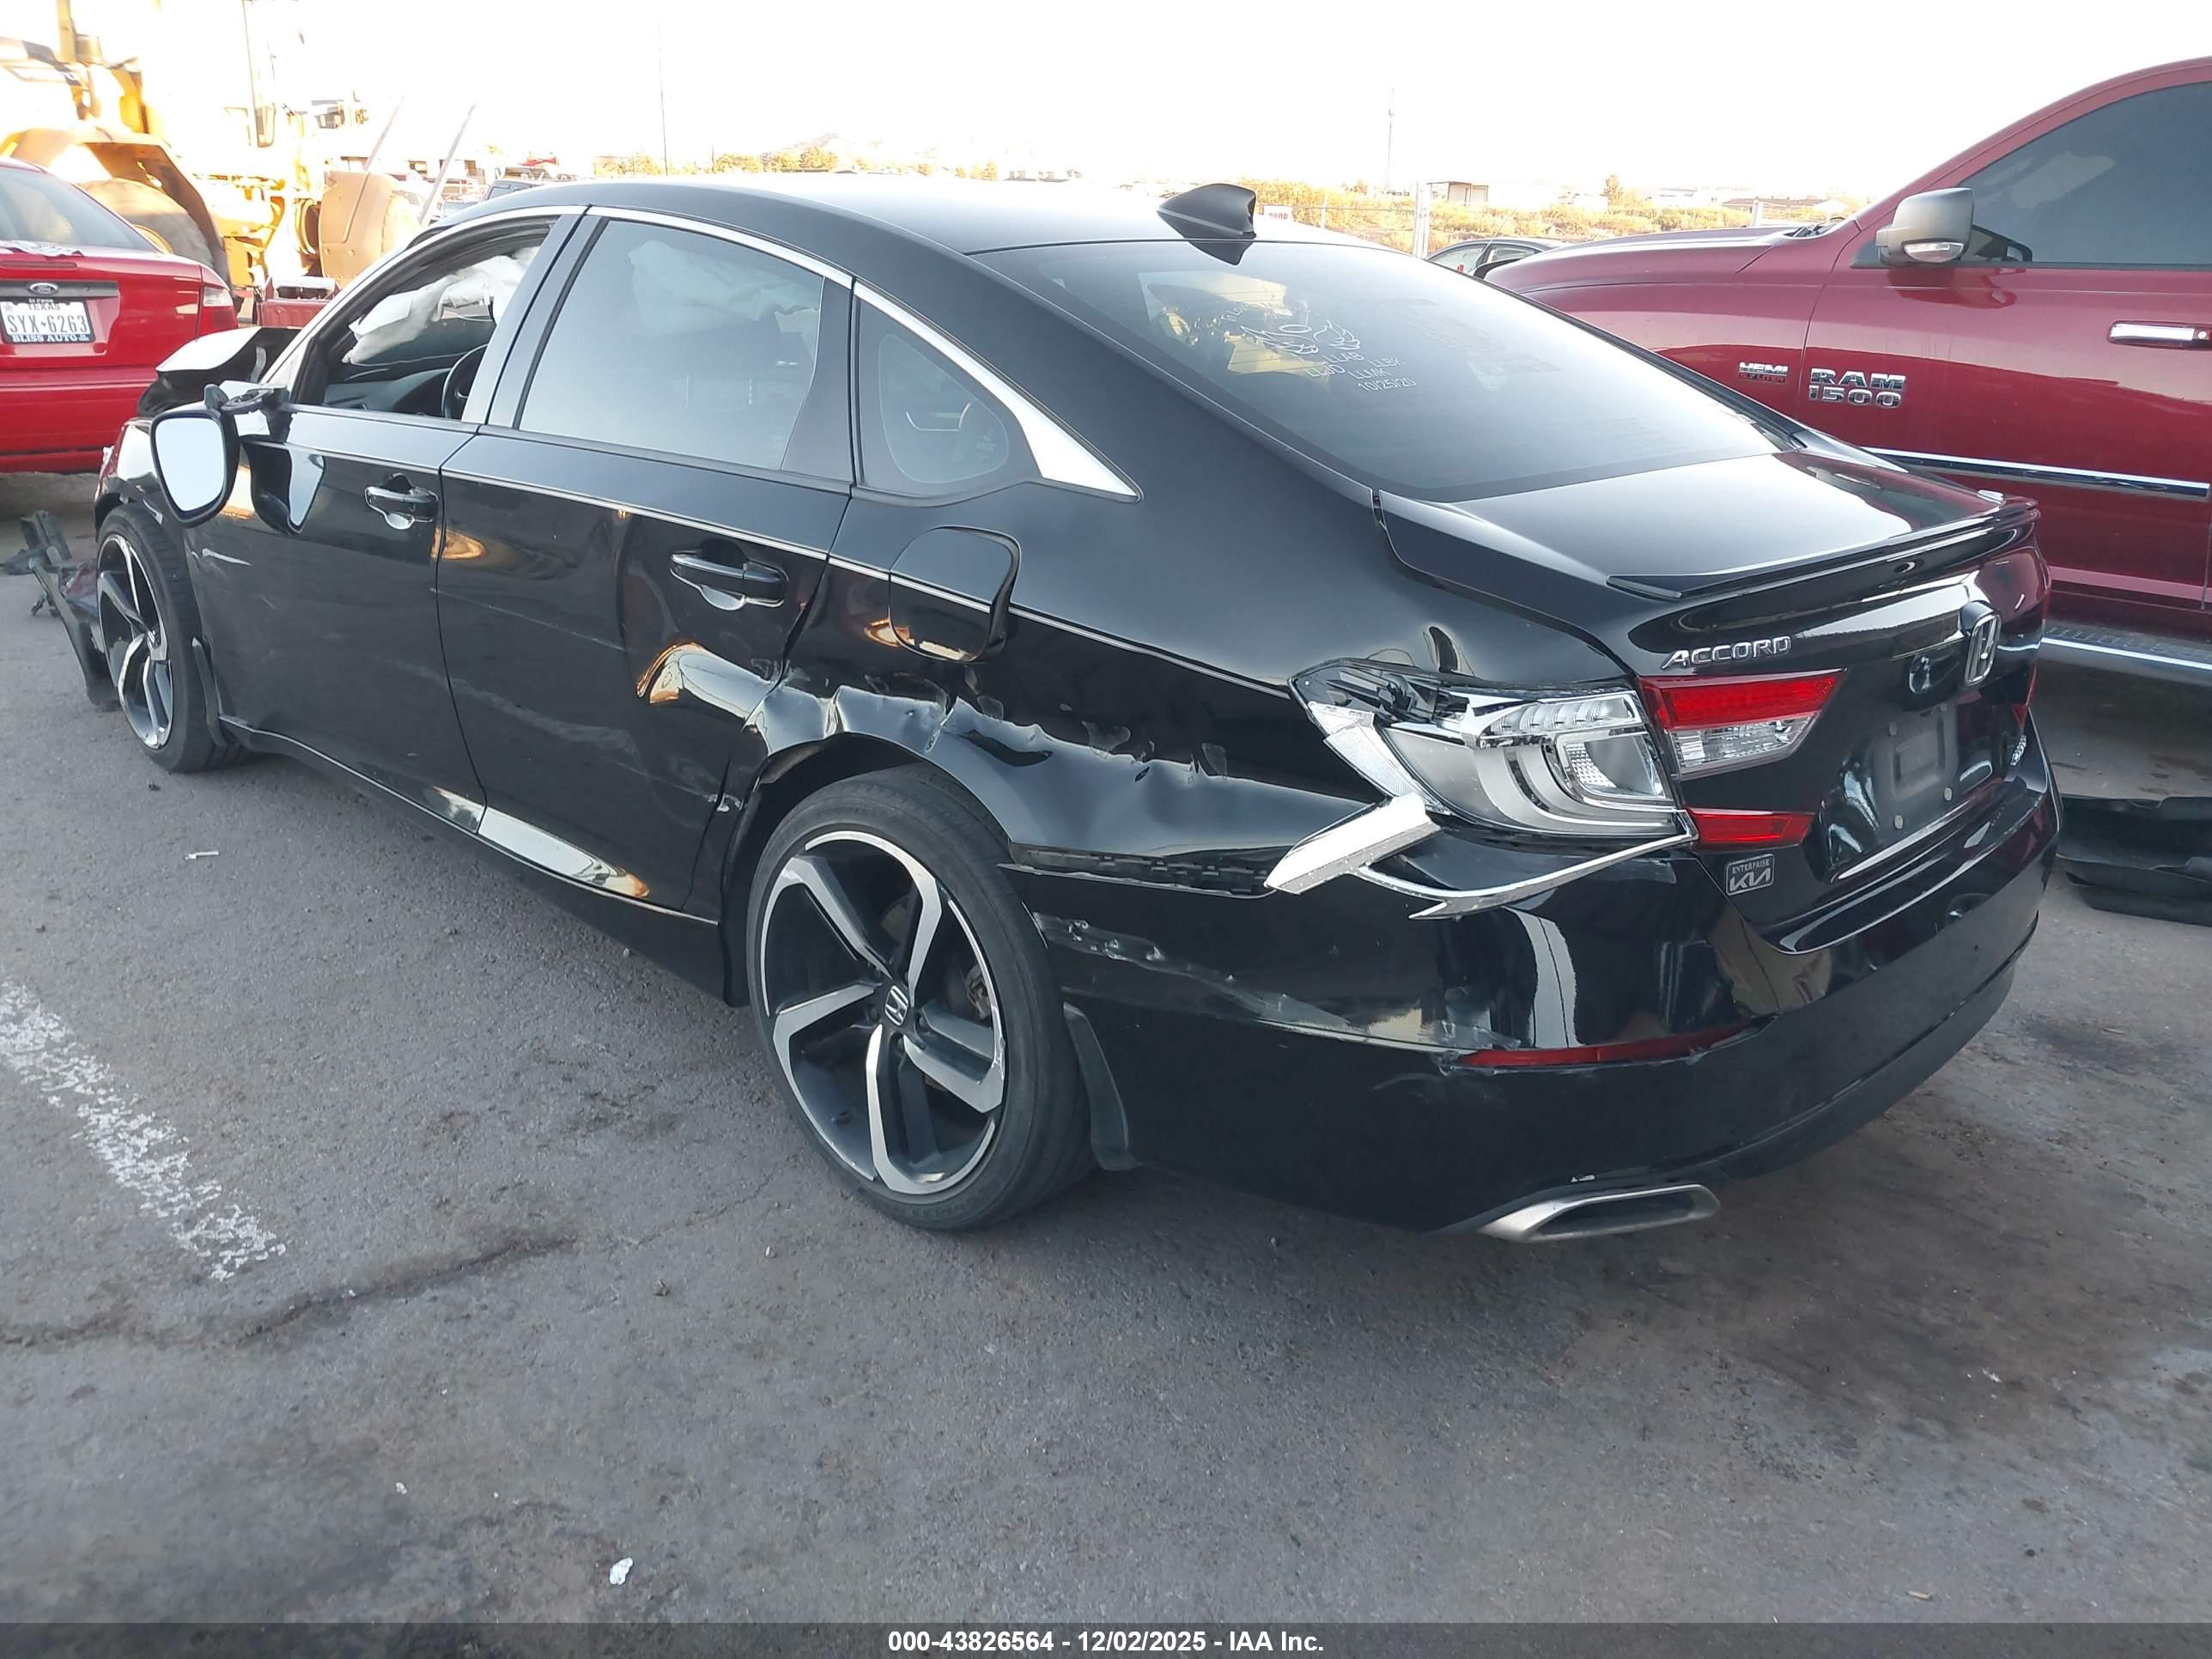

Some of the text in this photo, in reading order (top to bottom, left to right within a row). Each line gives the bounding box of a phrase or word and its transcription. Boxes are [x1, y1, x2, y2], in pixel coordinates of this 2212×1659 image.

[12, 333, 45, 343] BLISS
[47, 333, 77, 342] AUTO
[1739, 362, 1789, 375] HEMI
[1358, 377, 1417, 392] 10/25/20
[1810, 368, 1906, 390] RAM
[1808, 385, 1901, 408] 1500
[1662, 635, 1792, 670] ACCORD
[1732, 859, 1771, 874] ENTERPRISE
